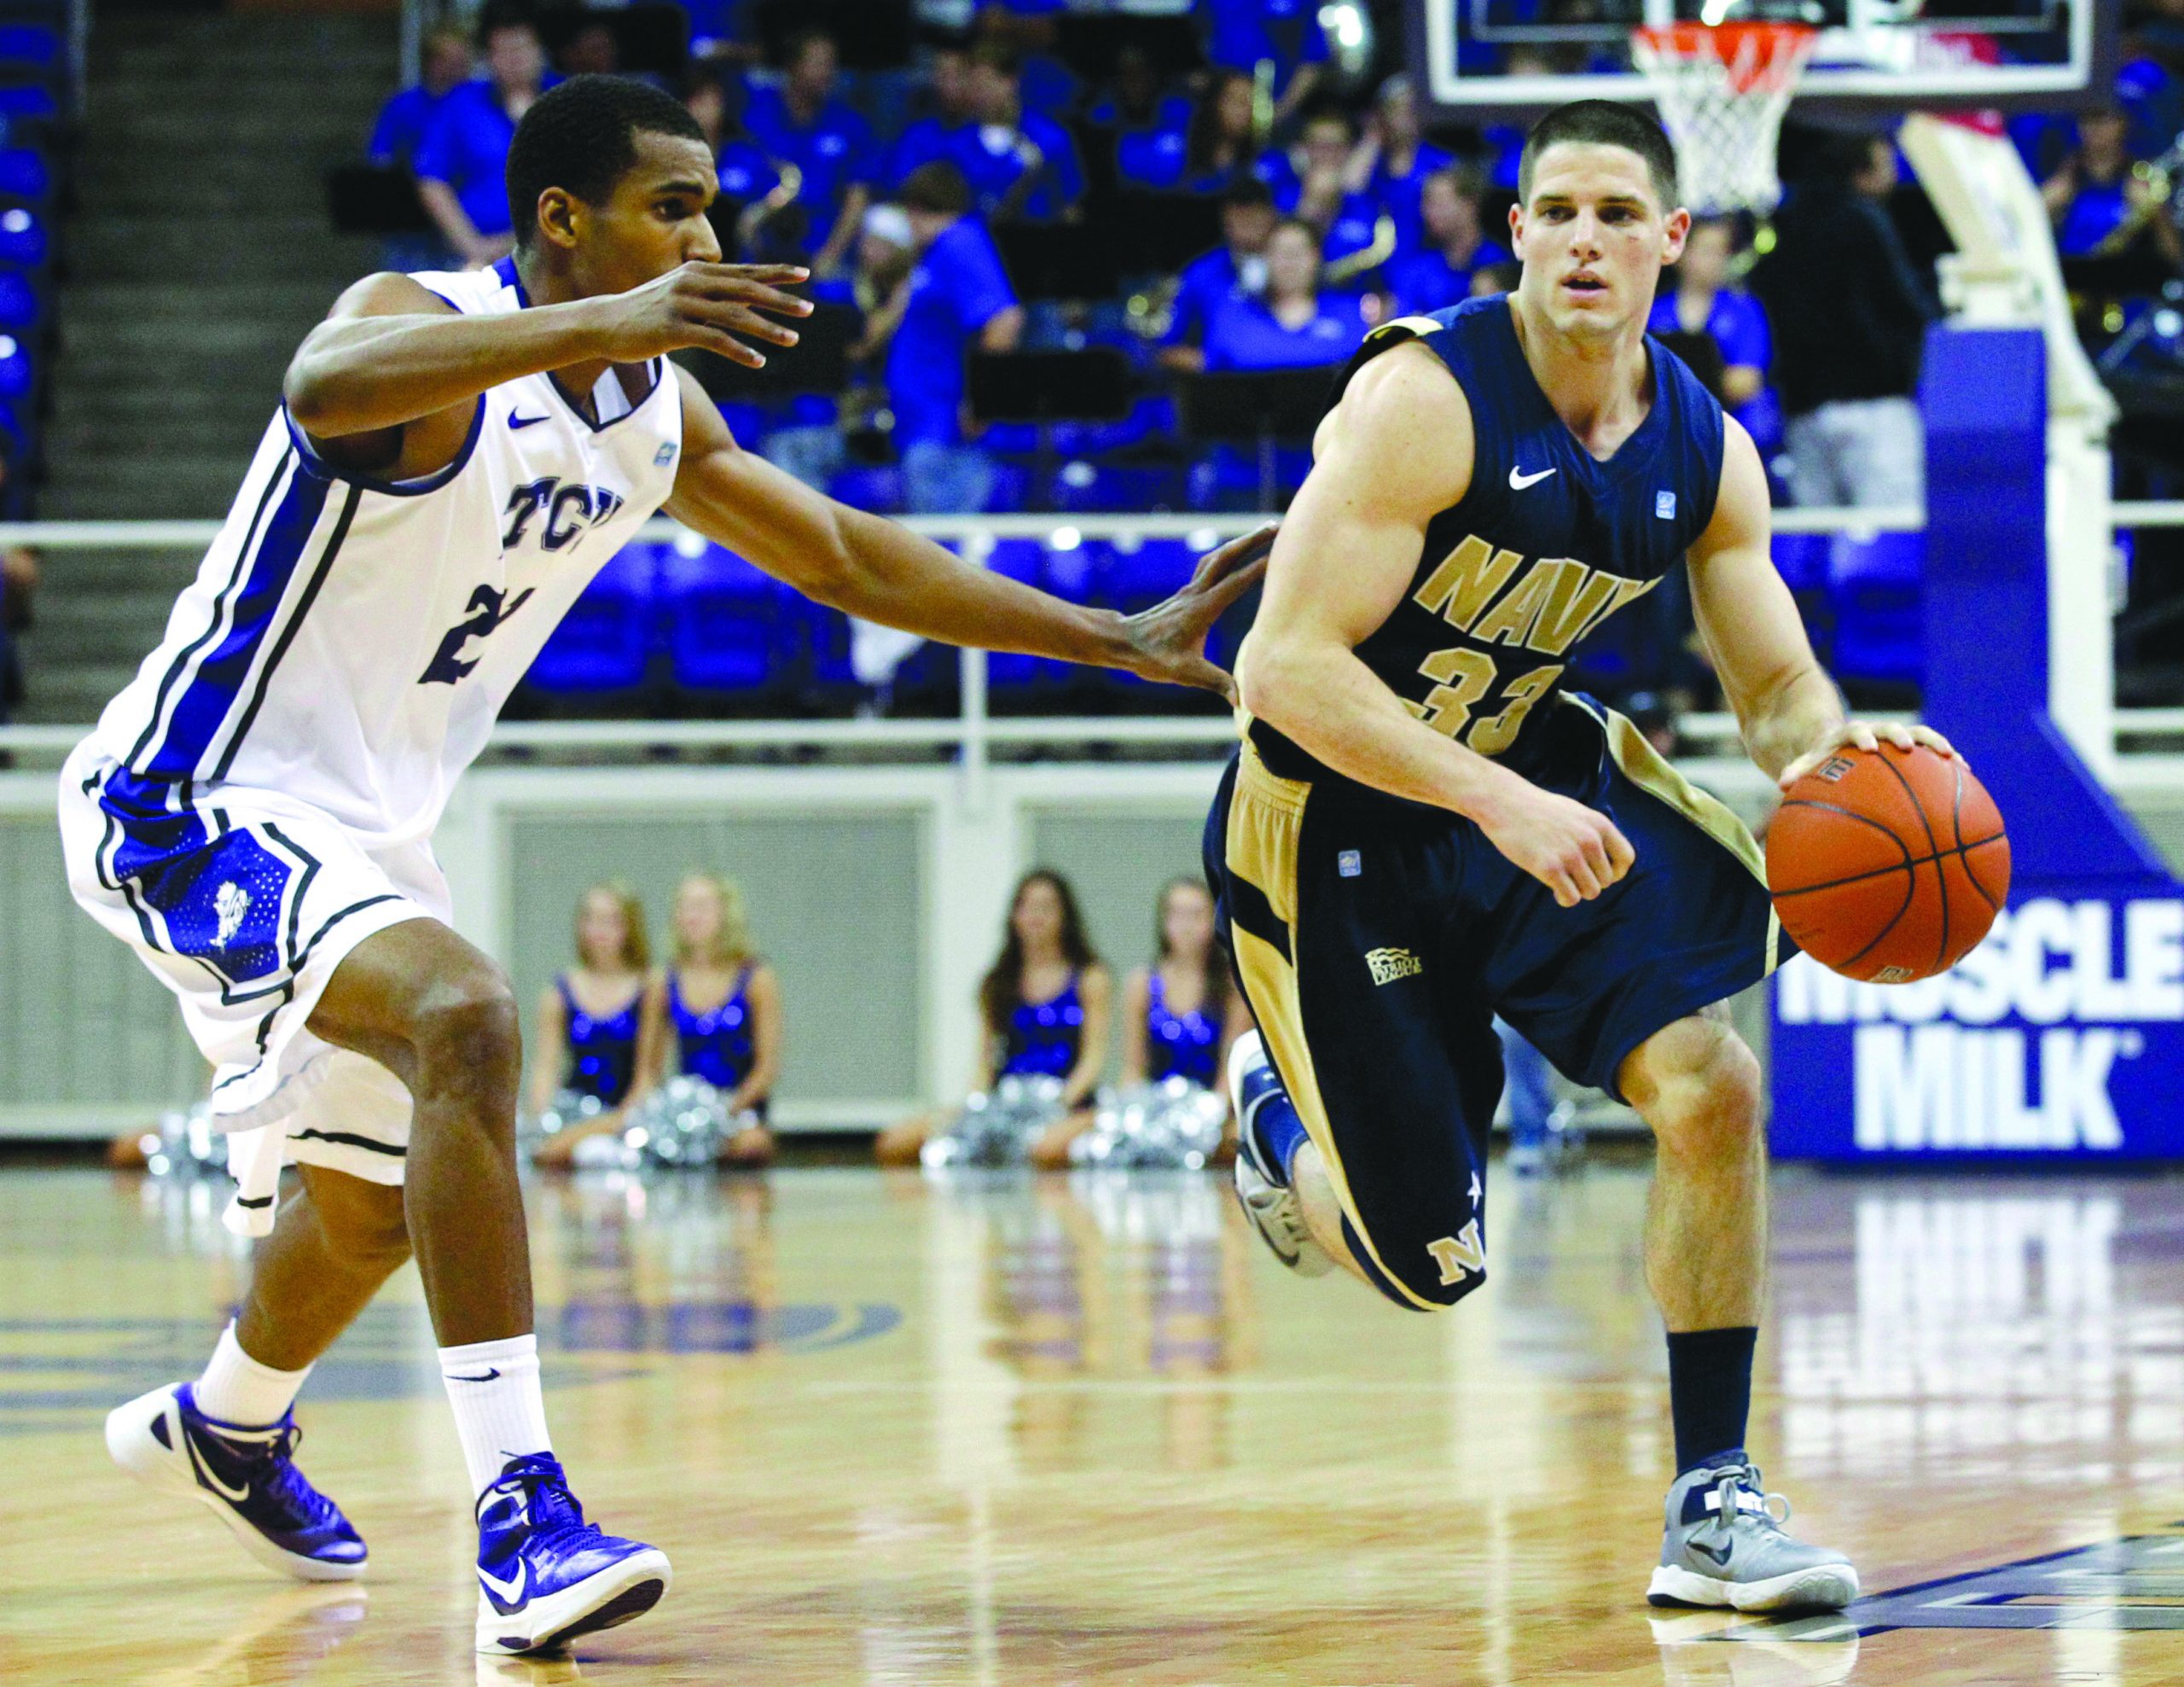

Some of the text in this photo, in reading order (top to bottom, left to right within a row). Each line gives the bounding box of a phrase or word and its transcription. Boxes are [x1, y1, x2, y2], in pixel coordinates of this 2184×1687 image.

[1399, 647, 1565, 756] 33
[1855, 1027, 2124, 1149] MILK
[1426, 1217, 1486, 1286] N
